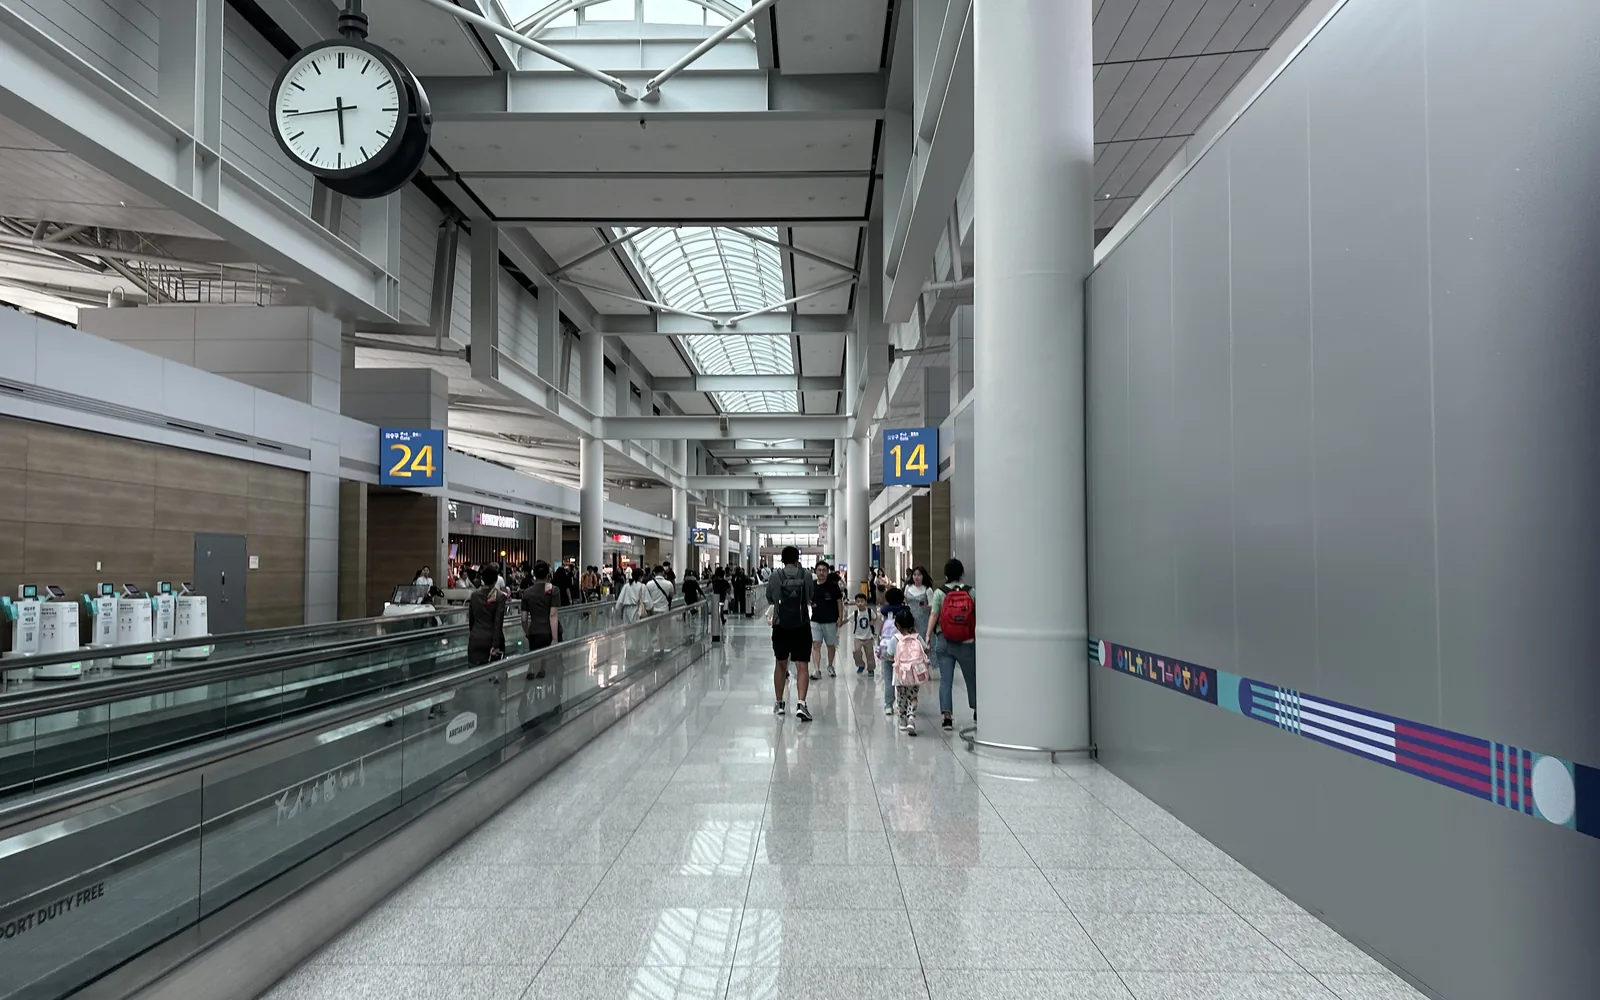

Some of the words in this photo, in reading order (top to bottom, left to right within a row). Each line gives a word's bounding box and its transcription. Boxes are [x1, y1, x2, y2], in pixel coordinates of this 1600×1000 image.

[389, 443, 436, 477] 24
[889, 443, 929, 478] 14
[693, 531, 706, 543] 23
[37, 895, 74, 926] DUTY
[75, 881, 105, 908] FREE
